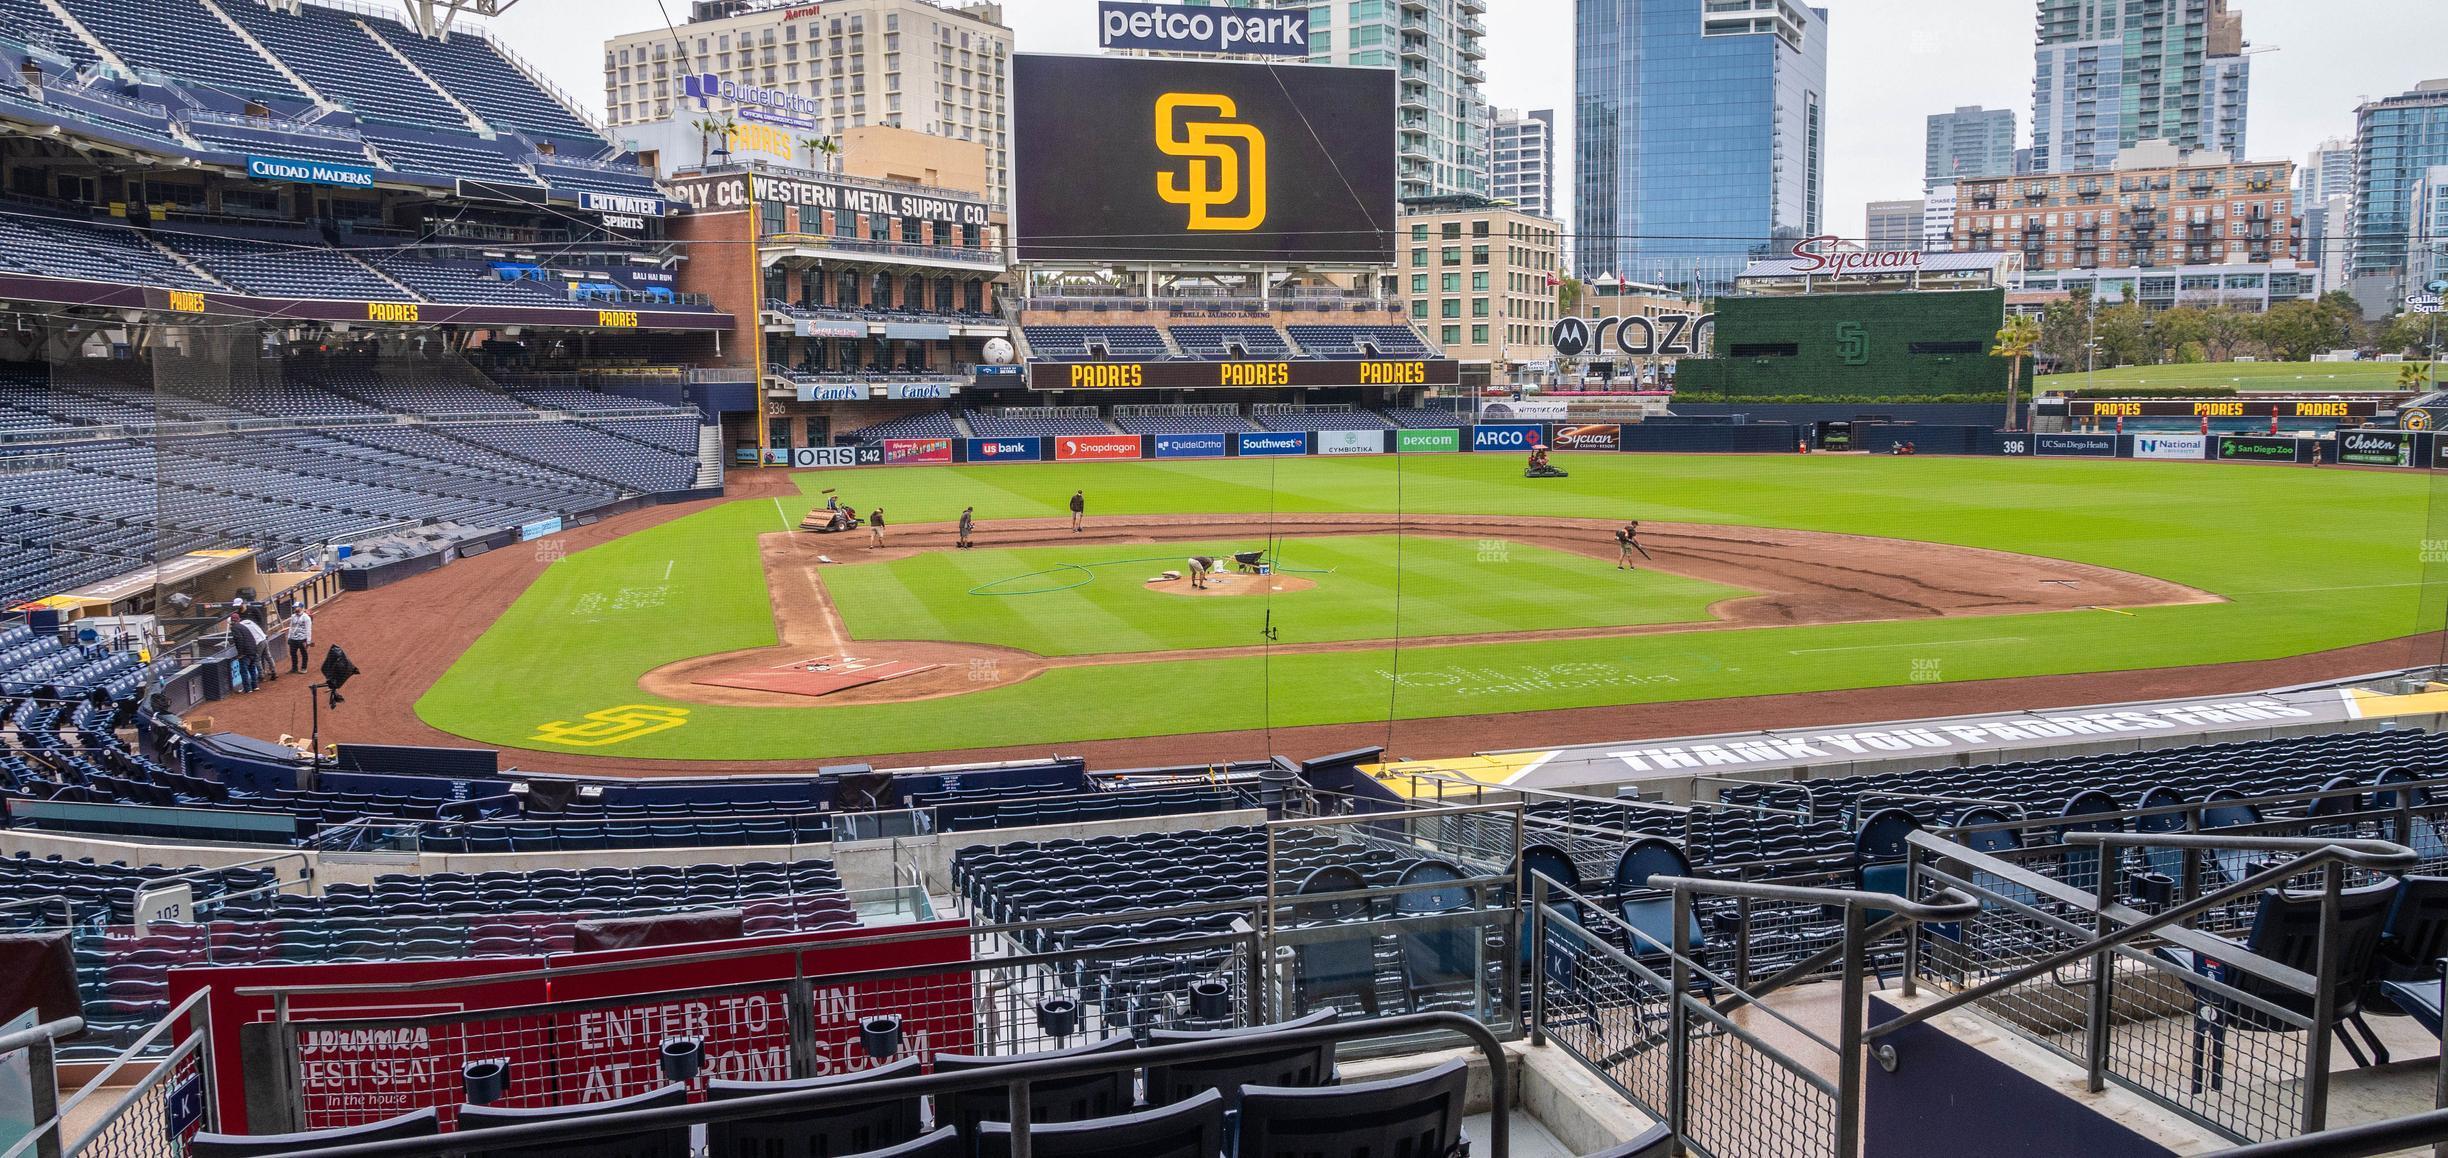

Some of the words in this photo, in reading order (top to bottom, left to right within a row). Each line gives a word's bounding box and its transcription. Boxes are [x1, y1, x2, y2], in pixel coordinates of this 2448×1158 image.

[784, 5, 820, 21] Marriott
[1104, 7, 1213, 45] petco
[1221, 13, 1305, 50] park
[721, 79, 817, 115] QuidelOrtho
[730, 125, 792, 161] PADRES
[1155, 92, 1266, 231] SD
[252, 161, 309, 179] CIUDAD
[312, 166, 372, 186] MADERAS
[590, 194, 656, 215] CUTWATER
[665, 182, 709, 209] PLY
[752, 177, 836, 207] WESTERN
[844, 189, 897, 215] METAL
[902, 197, 958, 222] SUPPLY
[963, 205, 988, 225] CO.
[603, 214, 644, 230] SPIRITS
[1790, 235, 1924, 281] Sycuan
[632, 272, 647, 281] BALI
[648, 272, 659, 281] HAI
[659, 272, 673, 282] RUM
[170, 289, 205, 313] PADRES
[368, 302, 419, 321] PADRES
[599, 311, 638, 327] PADRES
[1594, 313, 1714, 356] razr
[1071, 364, 1142, 387] PADRES
[1221, 363, 1288, 385] PADRES
[1360, 362, 1425, 384] PADRES
[812, 385, 857, 400] Canel's
[901, 384, 940, 399] Canel's
[769, 402, 786, 415] 336
[2296, 402, 2348, 416] PADRES
[1172, 440, 1223, 451] QuidelOrtho
[1243, 438, 1295, 450] Southwest
[1475, 431, 1523, 446] ARCO
[1556, 427, 1613, 448] Sycuan
[2042, 440, 2053, 448] UC
[2053, 440, 2066, 448] San
[2067, 440, 2086, 450] Diego
[2086, 441, 2109, 449] Health
[2160, 440, 2201, 448] National
[2345, 434, 2396, 449] Chosen
[860, 449, 880, 462] 342
[983, 445, 997, 454] us
[998, 443, 1025, 453] bank
[1080, 441, 1136, 454] Snapdragon
[2003, 441, 2024, 453] 396
[2253, 445, 2276, 455] Diego
[2277, 446, 2294, 454] Zoo
[798, 449, 853, 466] ORIS
[1606, 737, 1832, 772] THANK
[1821, 728, 1953, 754] YOU
[1938, 710, 2175, 744] PADRES
[2154, 700, 2314, 726] FANS
[156, 904, 180, 920] 103
[1554, 955, 1562, 976] K
[580, 1002, 709, 1051] ENTER
[720, 995, 770, 1035] TO
[780, 986, 856, 1028] IN
[371, 1057, 441, 1086] SEAT
[583, 1062, 631, 1103] AT
[180, 1094, 192, 1119] K
[328, 1095, 341, 1106] In
[344, 1094, 365, 1105] the
[368, 1093, 408, 1105] house
